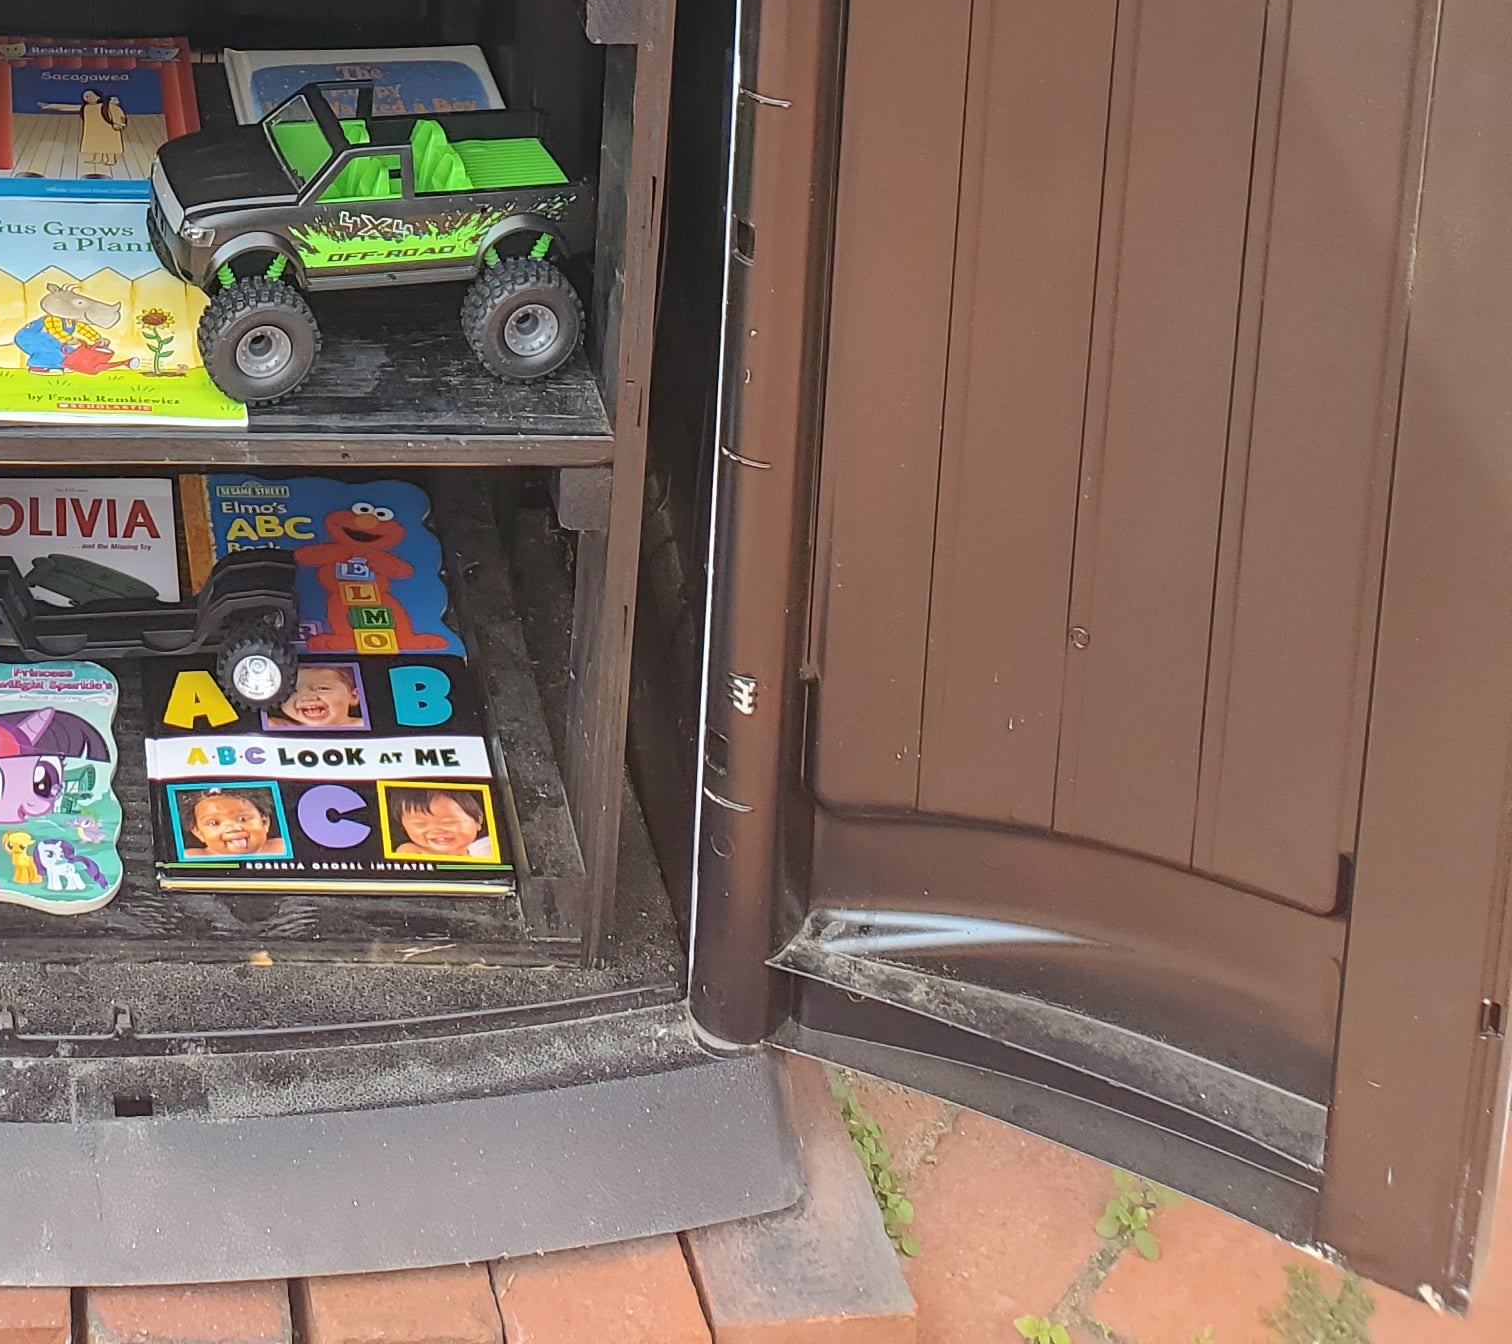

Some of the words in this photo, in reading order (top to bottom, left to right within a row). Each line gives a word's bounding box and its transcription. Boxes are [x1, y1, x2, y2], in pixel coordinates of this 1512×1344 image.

[31, 46, 88, 55] Readers'
[92, 47, 144, 55] Theater
[41, 72, 130, 83] Sacagawea
[43, 221, 134, 237] Grows
[52, 241, 67, 251] a
[327, 245, 457, 262] OFF-ROAD
[27, 393, 43, 401] by
[48, 394, 91, 402] Frank
[96, 395, 180, 404] Remkiewicz
[220, 487, 253, 496] SESAME
[256, 486, 287, 496] STREET
[221, 501, 287, 514] Elmo's
[227, 515, 315, 541] ABC
[13, 668, 73, 678] Princess
[164, 671, 238, 730] A
[389, 666, 453, 727] B
[278, 747, 365, 767] LOOK
[379, 752, 404, 764] AT
[415, 748, 460, 767] ME
[297, 784, 371, 849] C
[246, 862, 304, 870] ROBERTA
[371, 862, 434, 871] INTRATER
